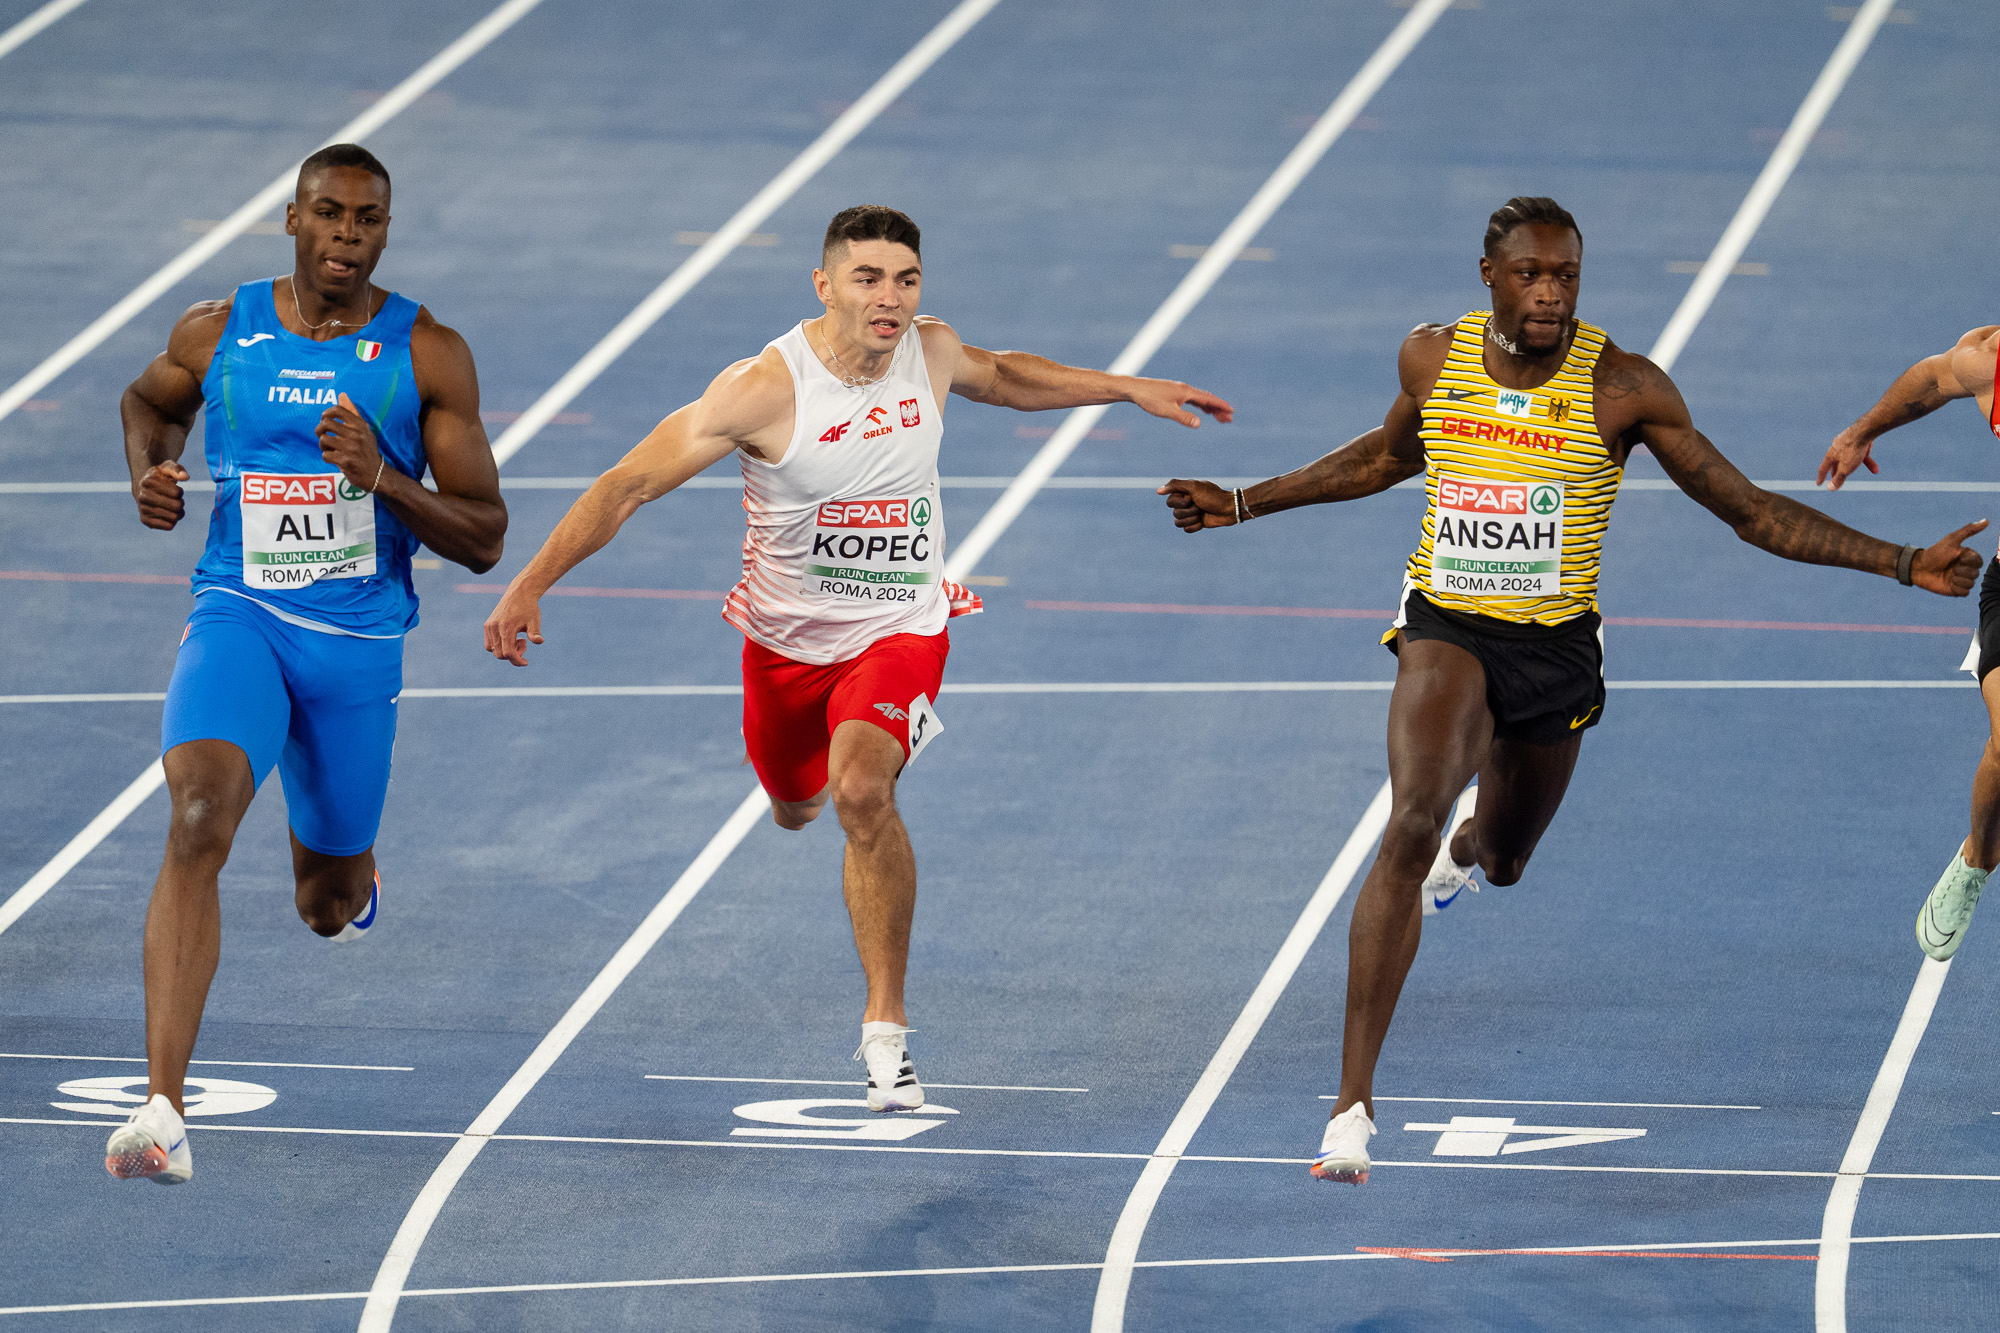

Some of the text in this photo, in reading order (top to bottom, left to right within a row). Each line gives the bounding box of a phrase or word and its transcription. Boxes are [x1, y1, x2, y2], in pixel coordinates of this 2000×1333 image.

[280, 368, 336, 377] FRECCIAROSSA
[267, 386, 338, 405] ITALIA
[818, 420, 852, 443] 4F
[863, 425, 893, 440] ORLEN
[1441, 416, 1568, 454] GERMANY
[245, 478, 334, 502] SPAR
[1440, 483, 1525, 511] SPAR
[820, 503, 906, 525] SPAR
[275, 512, 336, 542] ALI
[1436, 516, 1556, 550] ANSAH
[812, 528, 929, 562] KOPEĆ
[268, 553, 272, 564] I
[274, 552, 302, 564] RUN
[1454, 559, 1458, 570] I
[1459, 559, 1486, 572] RUN
[262, 568, 315, 583] ROMA
[831, 568, 836, 577] I
[837, 568, 865, 580] RUN
[1446, 574, 1543, 592] ROMA 2024
[820, 580, 917, 602] ROMA 2024
[873, 702, 910, 721] 4F
[729, 1098, 961, 1141] 5
[1403, 1116, 1648, 1157] 4
